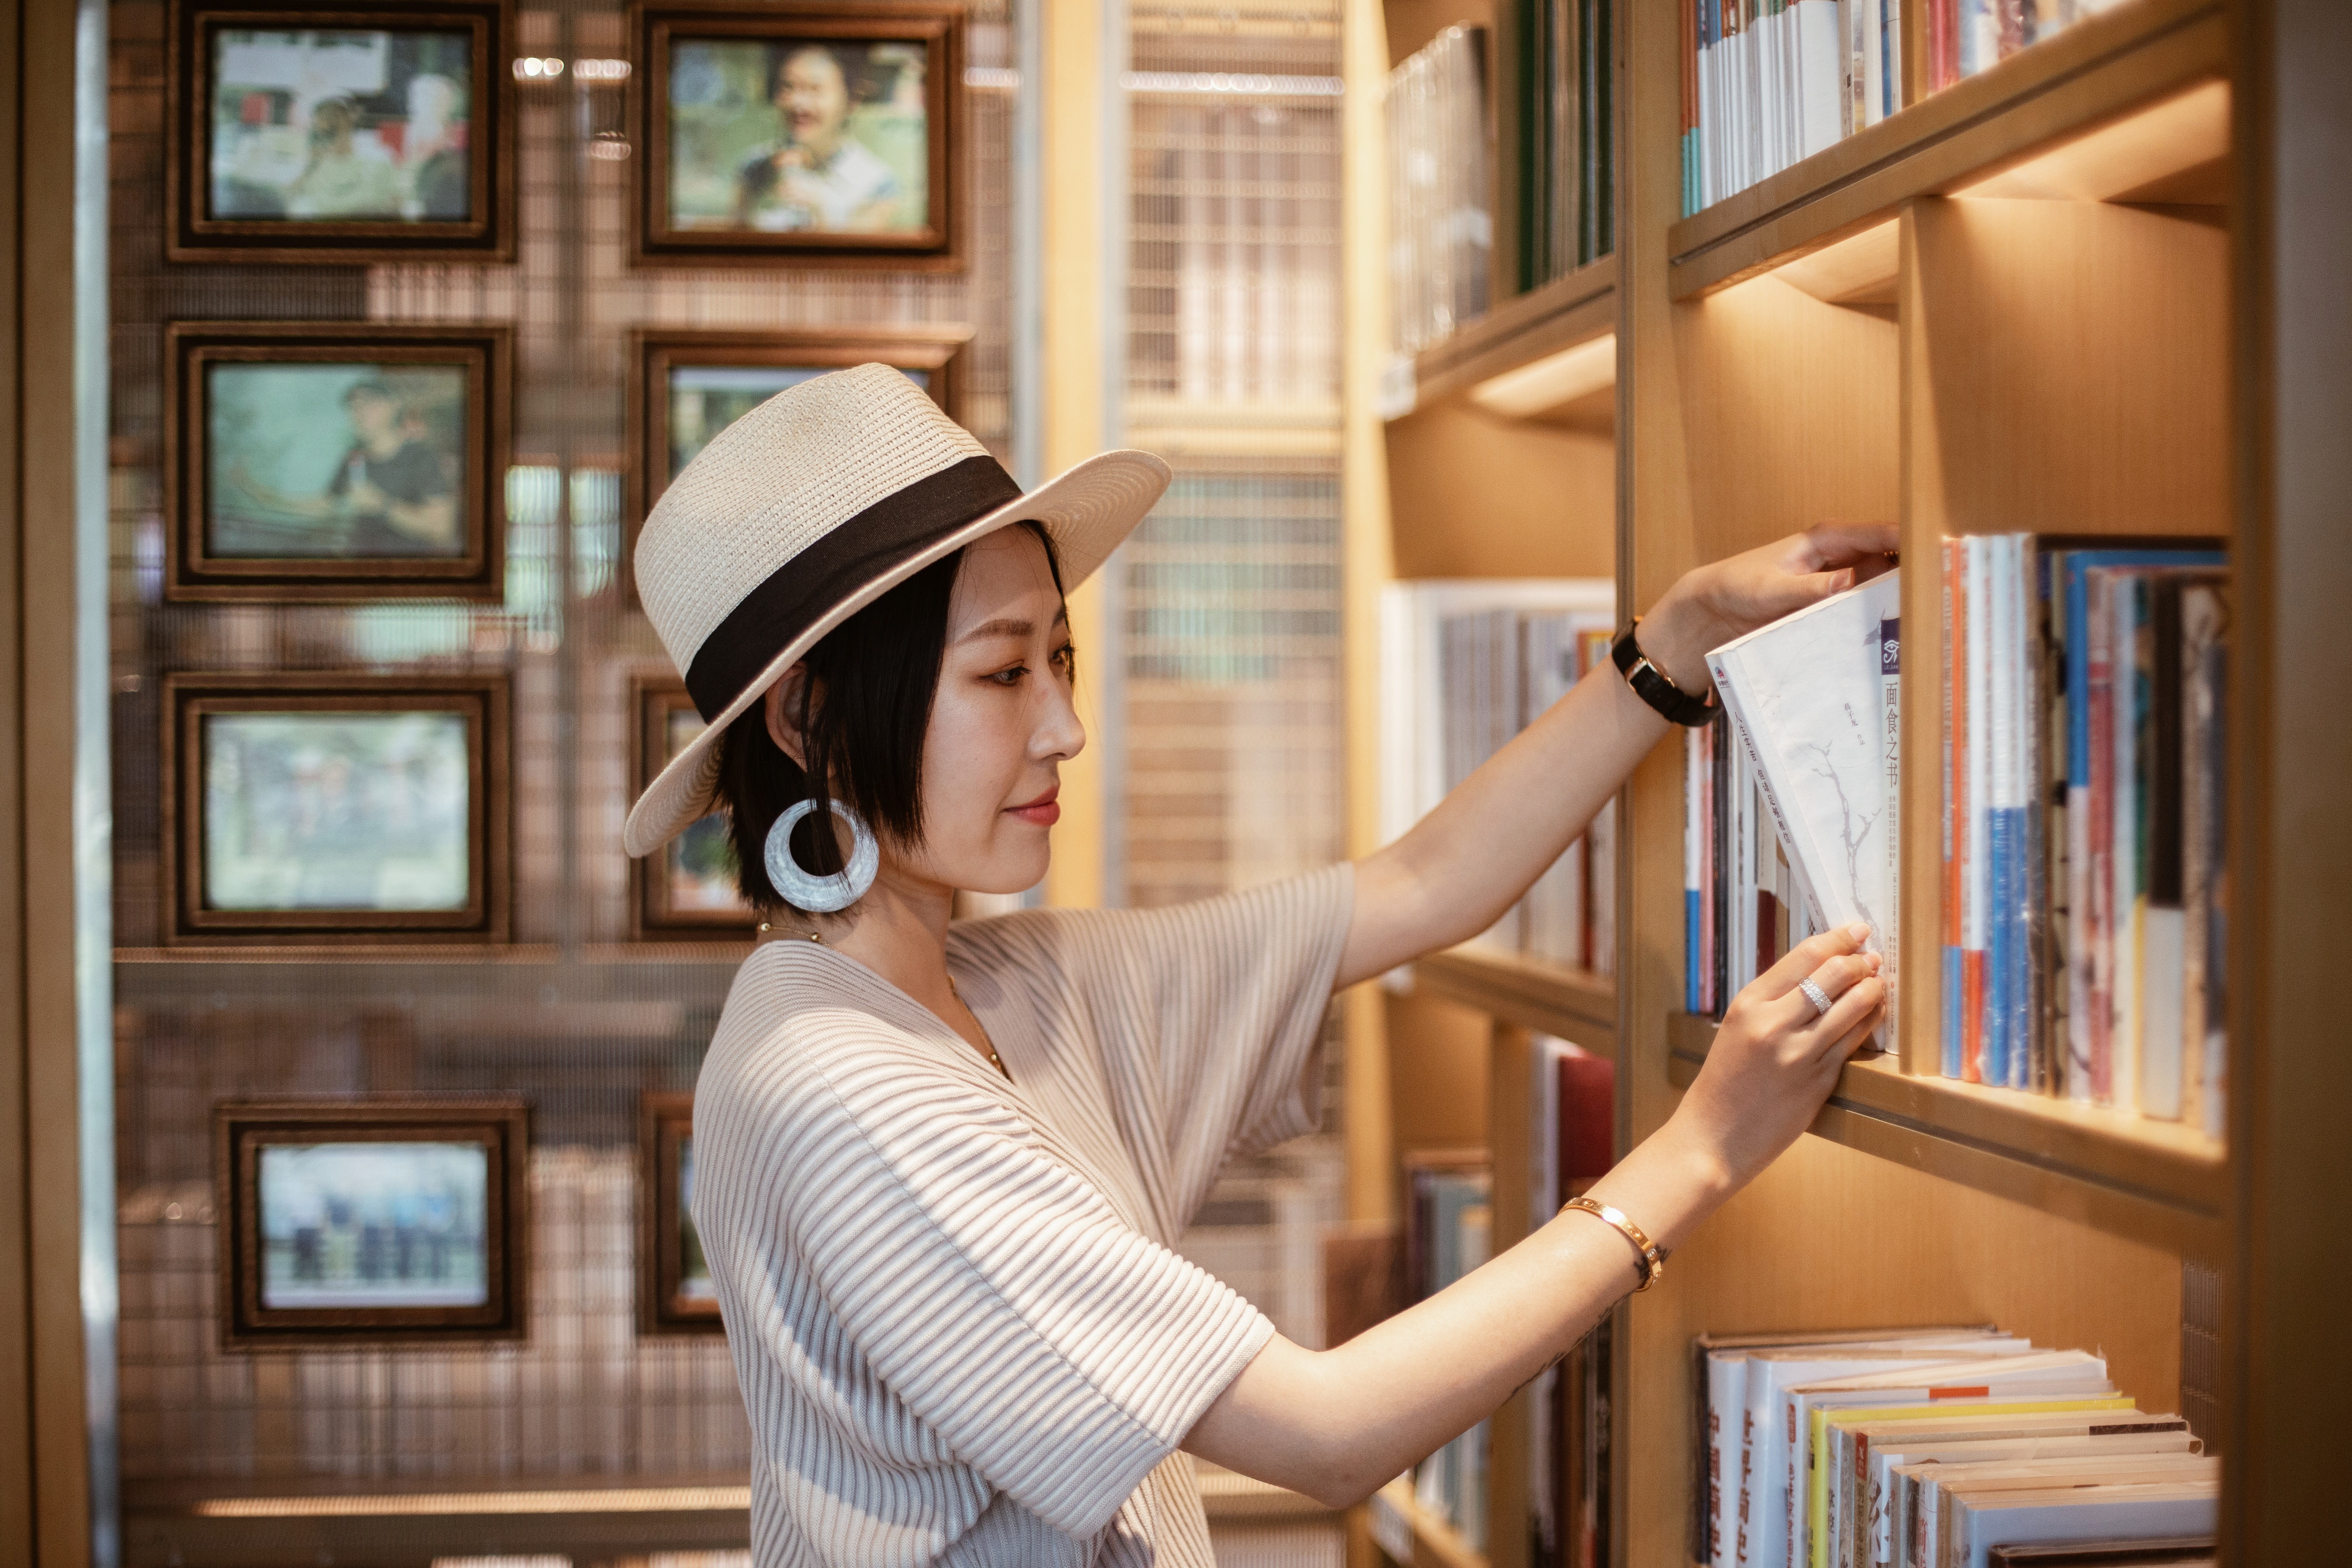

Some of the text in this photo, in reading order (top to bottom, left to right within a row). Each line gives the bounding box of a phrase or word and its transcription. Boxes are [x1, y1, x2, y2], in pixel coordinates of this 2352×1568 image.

[1735, 711, 1791, 844] 人生实苦 但请足够相信
[1886, 682, 1898, 788] 面食之书
